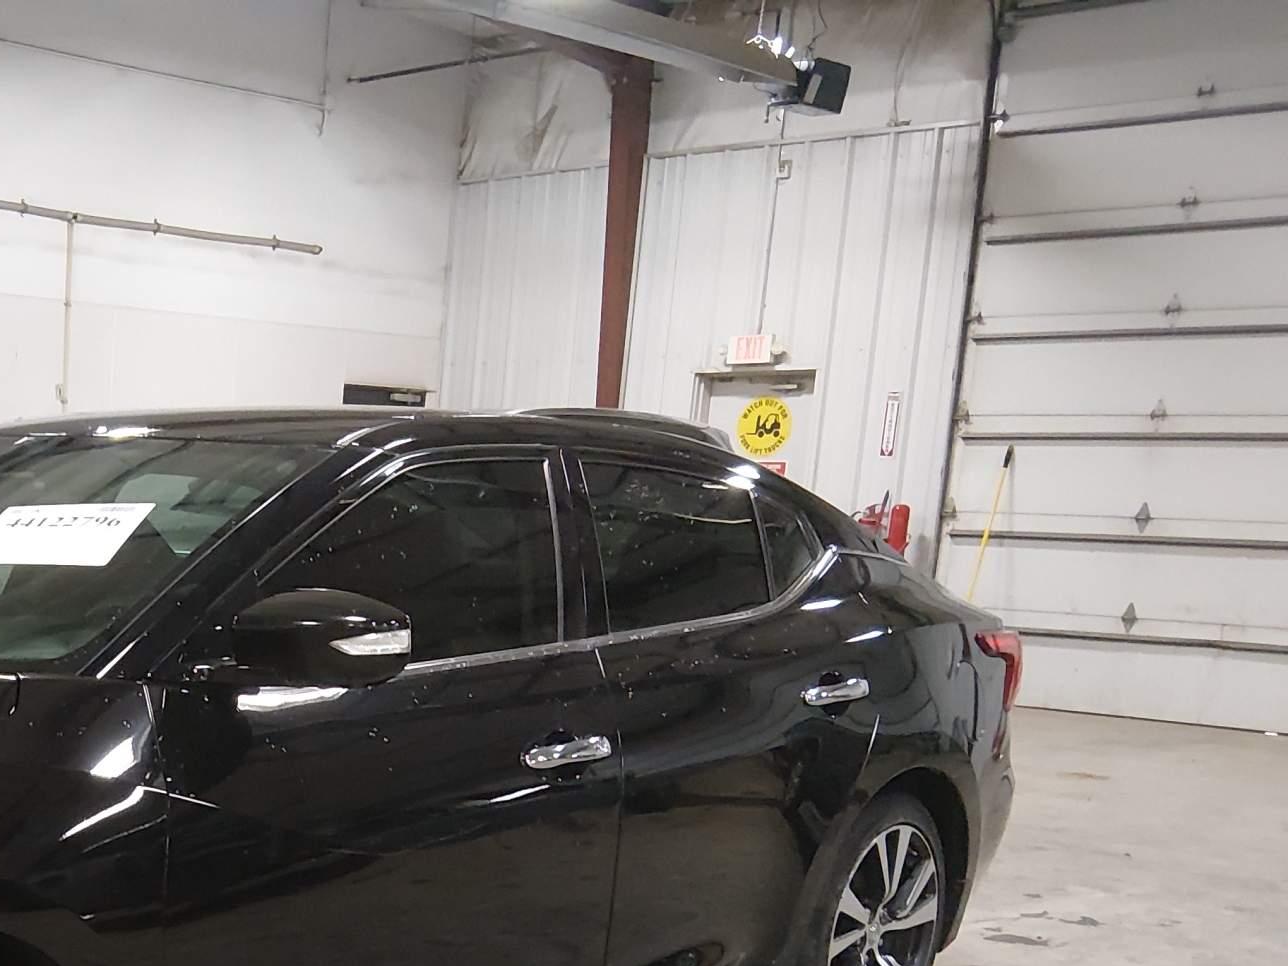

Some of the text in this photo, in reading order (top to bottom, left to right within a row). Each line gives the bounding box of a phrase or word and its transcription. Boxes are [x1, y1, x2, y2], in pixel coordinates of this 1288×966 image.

[735, 336, 766, 360] EXIT
[742, 399, 788, 420] WATCH OUT FOR
[5, 515, 121, 528] 44122796
